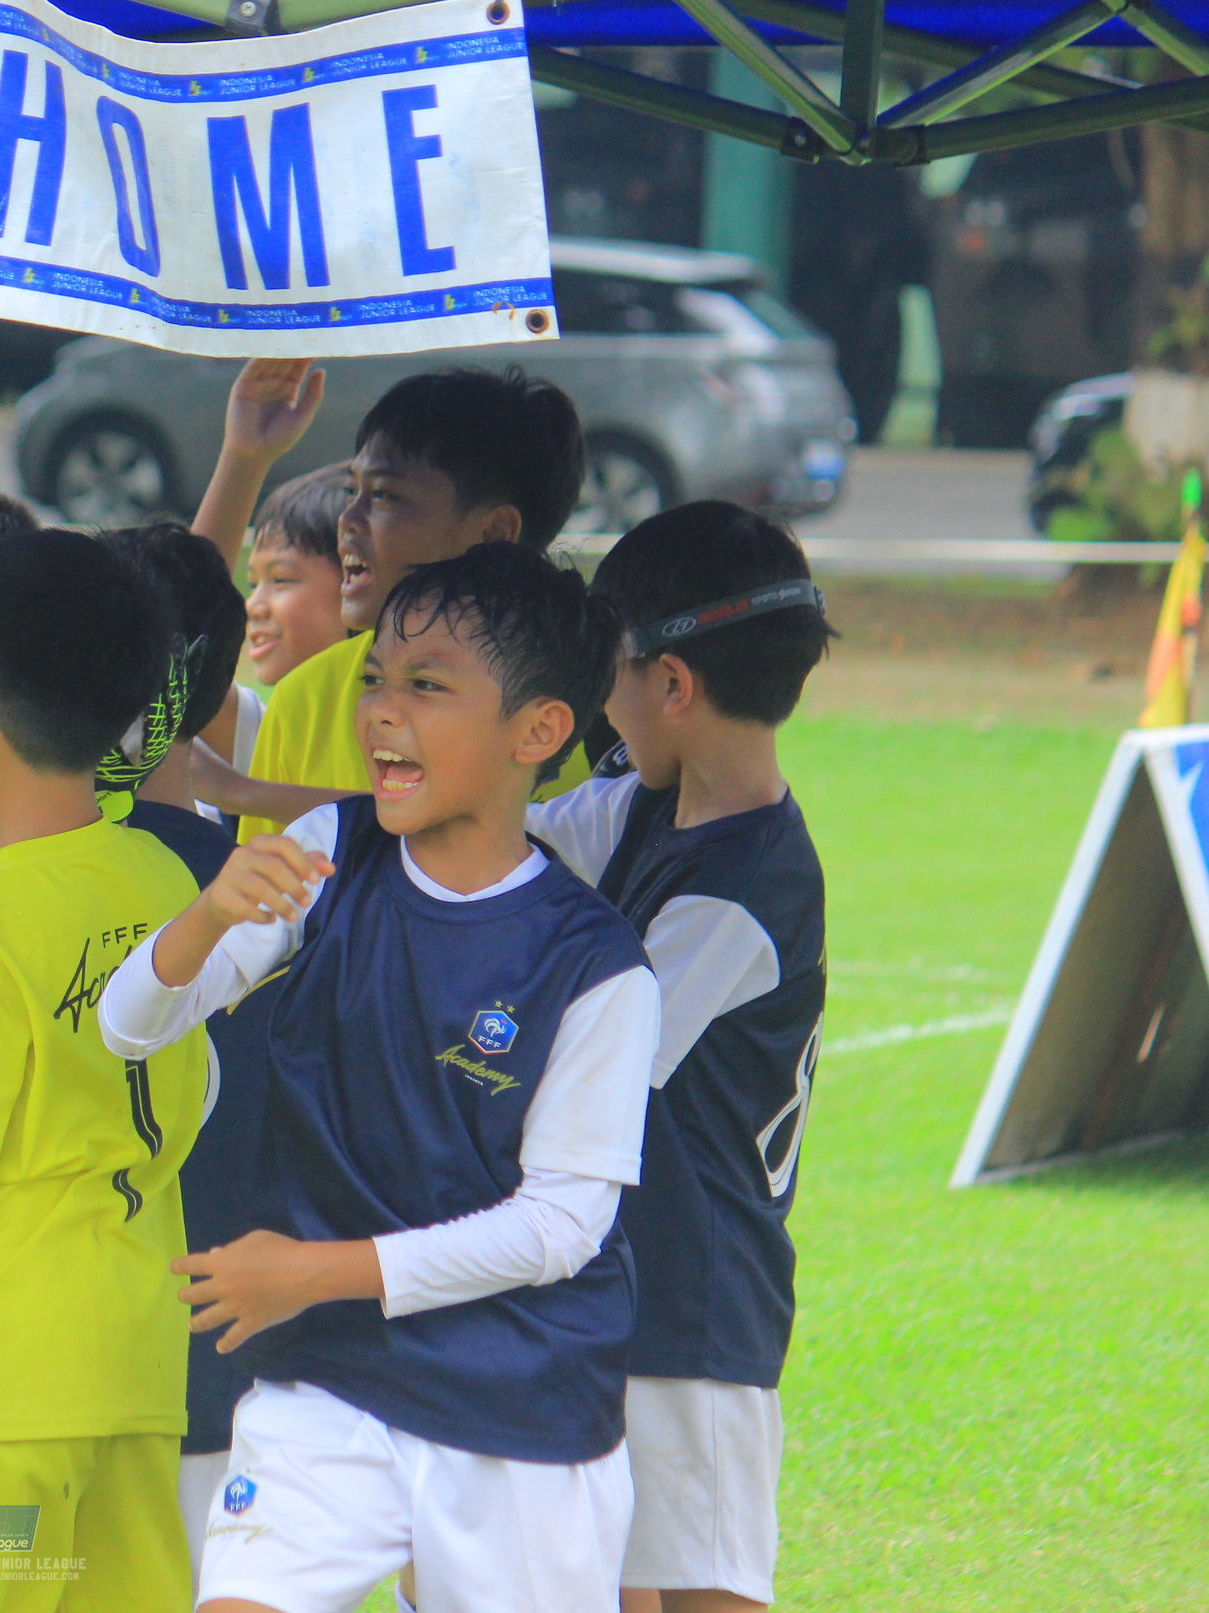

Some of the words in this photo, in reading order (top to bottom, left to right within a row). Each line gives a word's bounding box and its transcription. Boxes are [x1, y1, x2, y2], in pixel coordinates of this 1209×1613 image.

[447, 36, 500, 50] INDONESIA
[448, 47, 483, 59] JUNIOR
[486, 42, 525, 54] LEAGUE
[331, 53, 384, 68] INDONESIA
[332, 64, 367, 76] JUNIOR
[370, 57, 407, 70] LEAGUE
[220, 75, 273, 86] INDONESIA
[220, 84, 256, 95] JUNIOR
[260, 79, 295, 92] LEAGUE
[149, 86, 182, 97] LEAGUE
[53, 272, 104, 287] INDONESIA
[52, 281, 87, 292] JUNIOR
[89, 287, 123, 300] LEAGUE
[473, 286, 526, 298] INDONESIA
[359, 300, 412, 311] INDONESIA
[474, 294, 510, 306] JUNIOR
[513, 292, 547, 302] LEAGUE
[179, 313, 212, 323] LEAGUE
[246, 309, 298, 317] INDONESIA
[361, 308, 396, 319] JUNIOR
[399, 304, 435, 315] LEAGUE
[247, 316, 282, 324] JUNIOR
[285, 315, 321, 323] LEAGUE
[101, 922, 148, 948] FFF
[478, 1035, 501, 1048] FFF
[435, 1043, 522, 1097] Academy
[756, 1010, 824, 1198] 8
